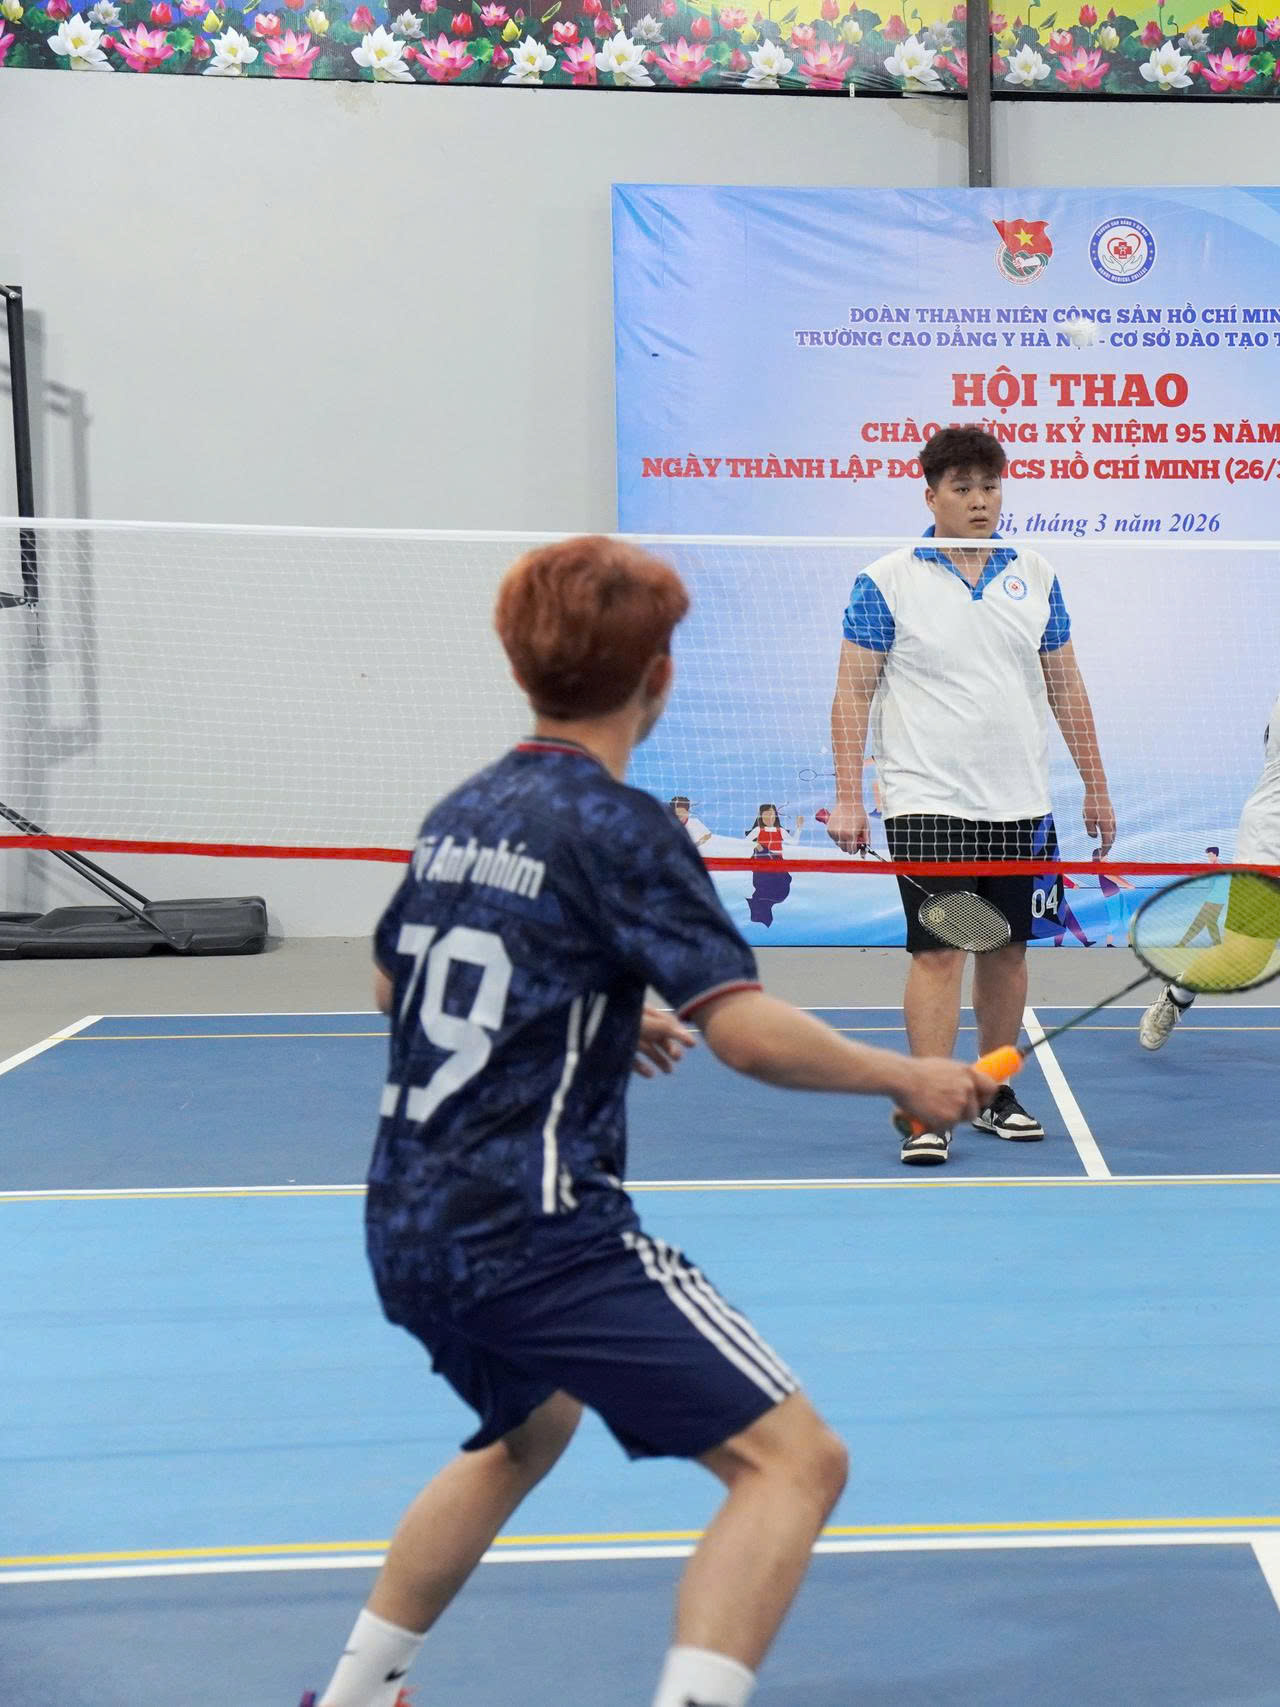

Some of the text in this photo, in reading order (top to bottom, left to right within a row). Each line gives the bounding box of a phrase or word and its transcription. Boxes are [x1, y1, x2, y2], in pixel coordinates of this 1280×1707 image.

[850, 305, 911, 323] ĐOÀN
[916, 308, 993, 323] THANH
[996, 305, 1048, 323] NIÊN
[1053, 305, 1111, 323] CÔNG
[1117, 305, 1162, 323] SẢN
[1168, 303, 1197, 323] HỒ
[1201, 305, 1238, 323] CHÍ
[795, 328, 882, 346] TRƯỜNG
[888, 331, 931, 346] CAO
[936, 324, 998, 347] ĐẲNG
[1002, 332, 1016, 346] Y
[1020, 328, 1051, 346] HÀ
[1110, 331, 1138, 347] CƠ
[1143, 328, 1171, 347] SỞ
[1176, 328, 1219, 347] ĐÀO
[1225, 332, 1268, 349] TẠO
[951, 364, 1189, 415] HỘI THAO
[860, 417, 941, 443] CHÀO
[1046, 416, 1086, 443] KỶ
[1092, 419, 1169, 447] NIỆM
[1175, 423, 1207, 443] 95
[641, 453, 722, 479] NGÀY
[726, 453, 825, 479] THÀNH
[830, 455, 883, 483] LẬP
[1050, 450, 1089, 480] HỒ
[1093, 454, 1140, 480] CHÍ
[1145, 459, 1221, 480] MINH
[1026, 512, 1088, 537] tháng
[1095, 513, 1108, 532] 3
[1114, 514, 1162, 532] năm
[1169, 513, 1221, 532] 2026
[1031, 884, 1059, 919] 04
